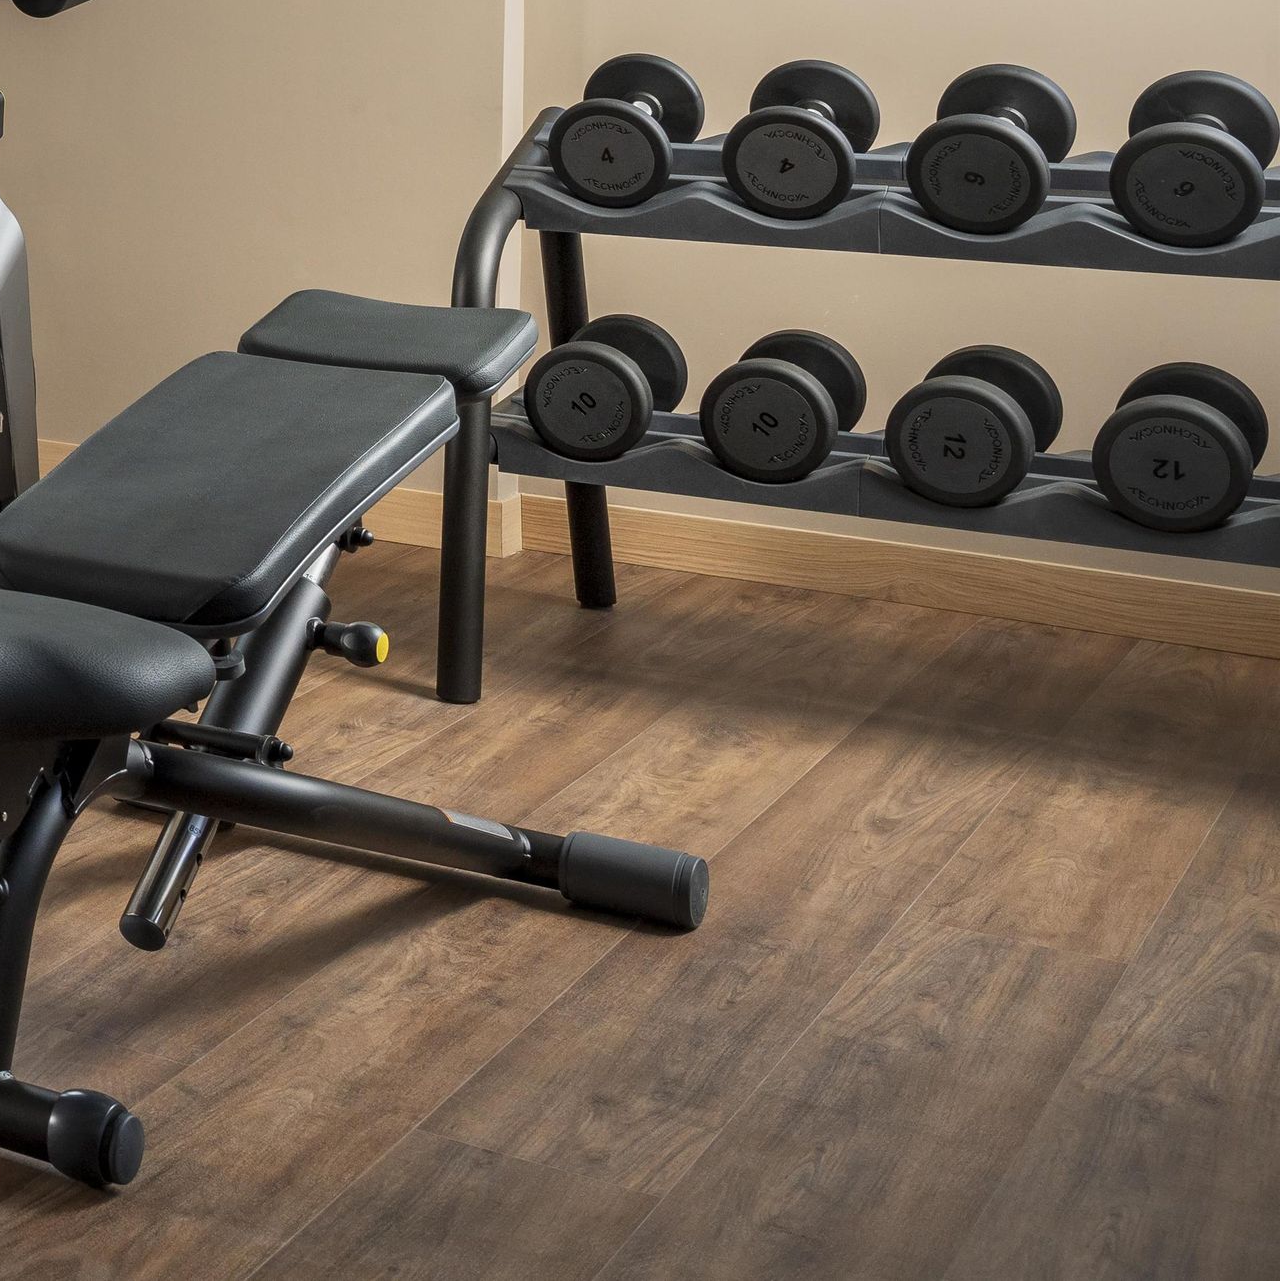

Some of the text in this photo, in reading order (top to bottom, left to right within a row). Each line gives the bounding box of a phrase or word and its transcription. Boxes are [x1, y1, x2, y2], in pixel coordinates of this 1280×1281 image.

[601, 147, 614, 164] 4
[780, 158, 794, 174] 4
[571, 392, 597, 416] 10
[752, 412, 778, 436] 10
[943, 433, 967, 460] 12
[1152, 459, 1185, 480] 12
